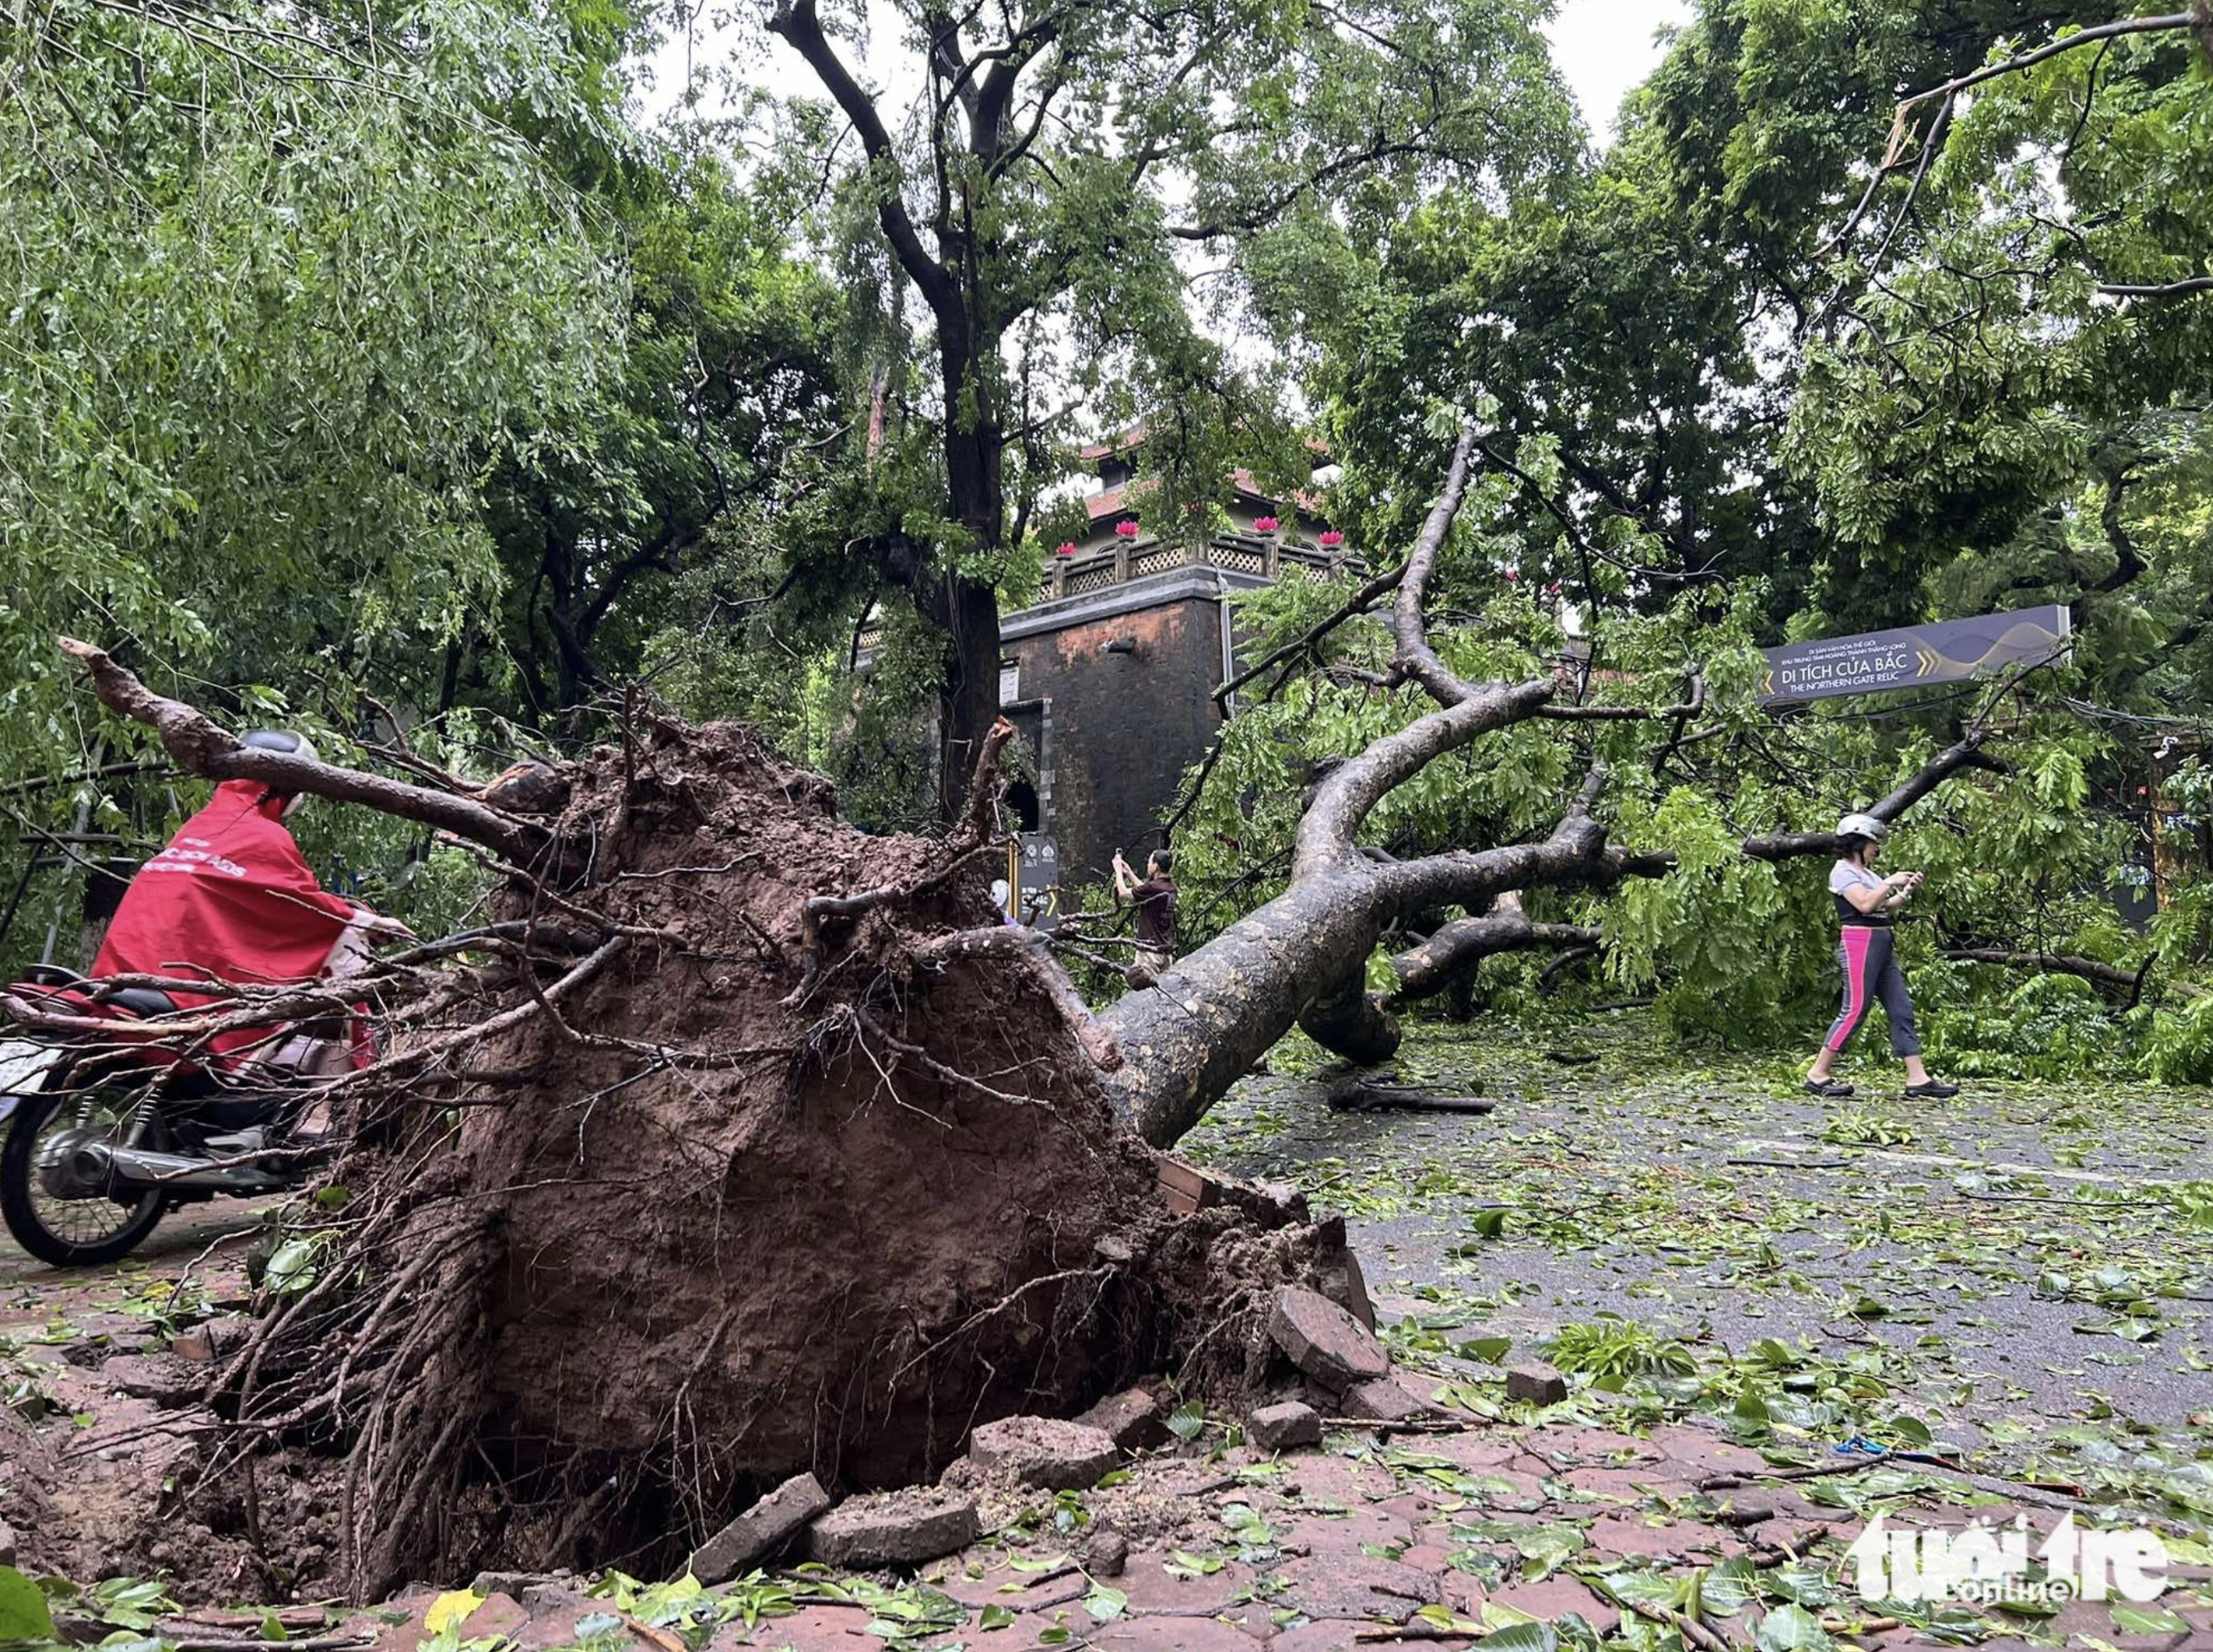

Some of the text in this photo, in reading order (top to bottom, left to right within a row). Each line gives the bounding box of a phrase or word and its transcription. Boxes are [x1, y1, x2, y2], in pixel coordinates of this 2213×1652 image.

[1782, 650, 1907, 684] DI TÍCH CỬA BẮC
[1790, 671, 1900, 693] THE NORTHERN GATE RELIC
